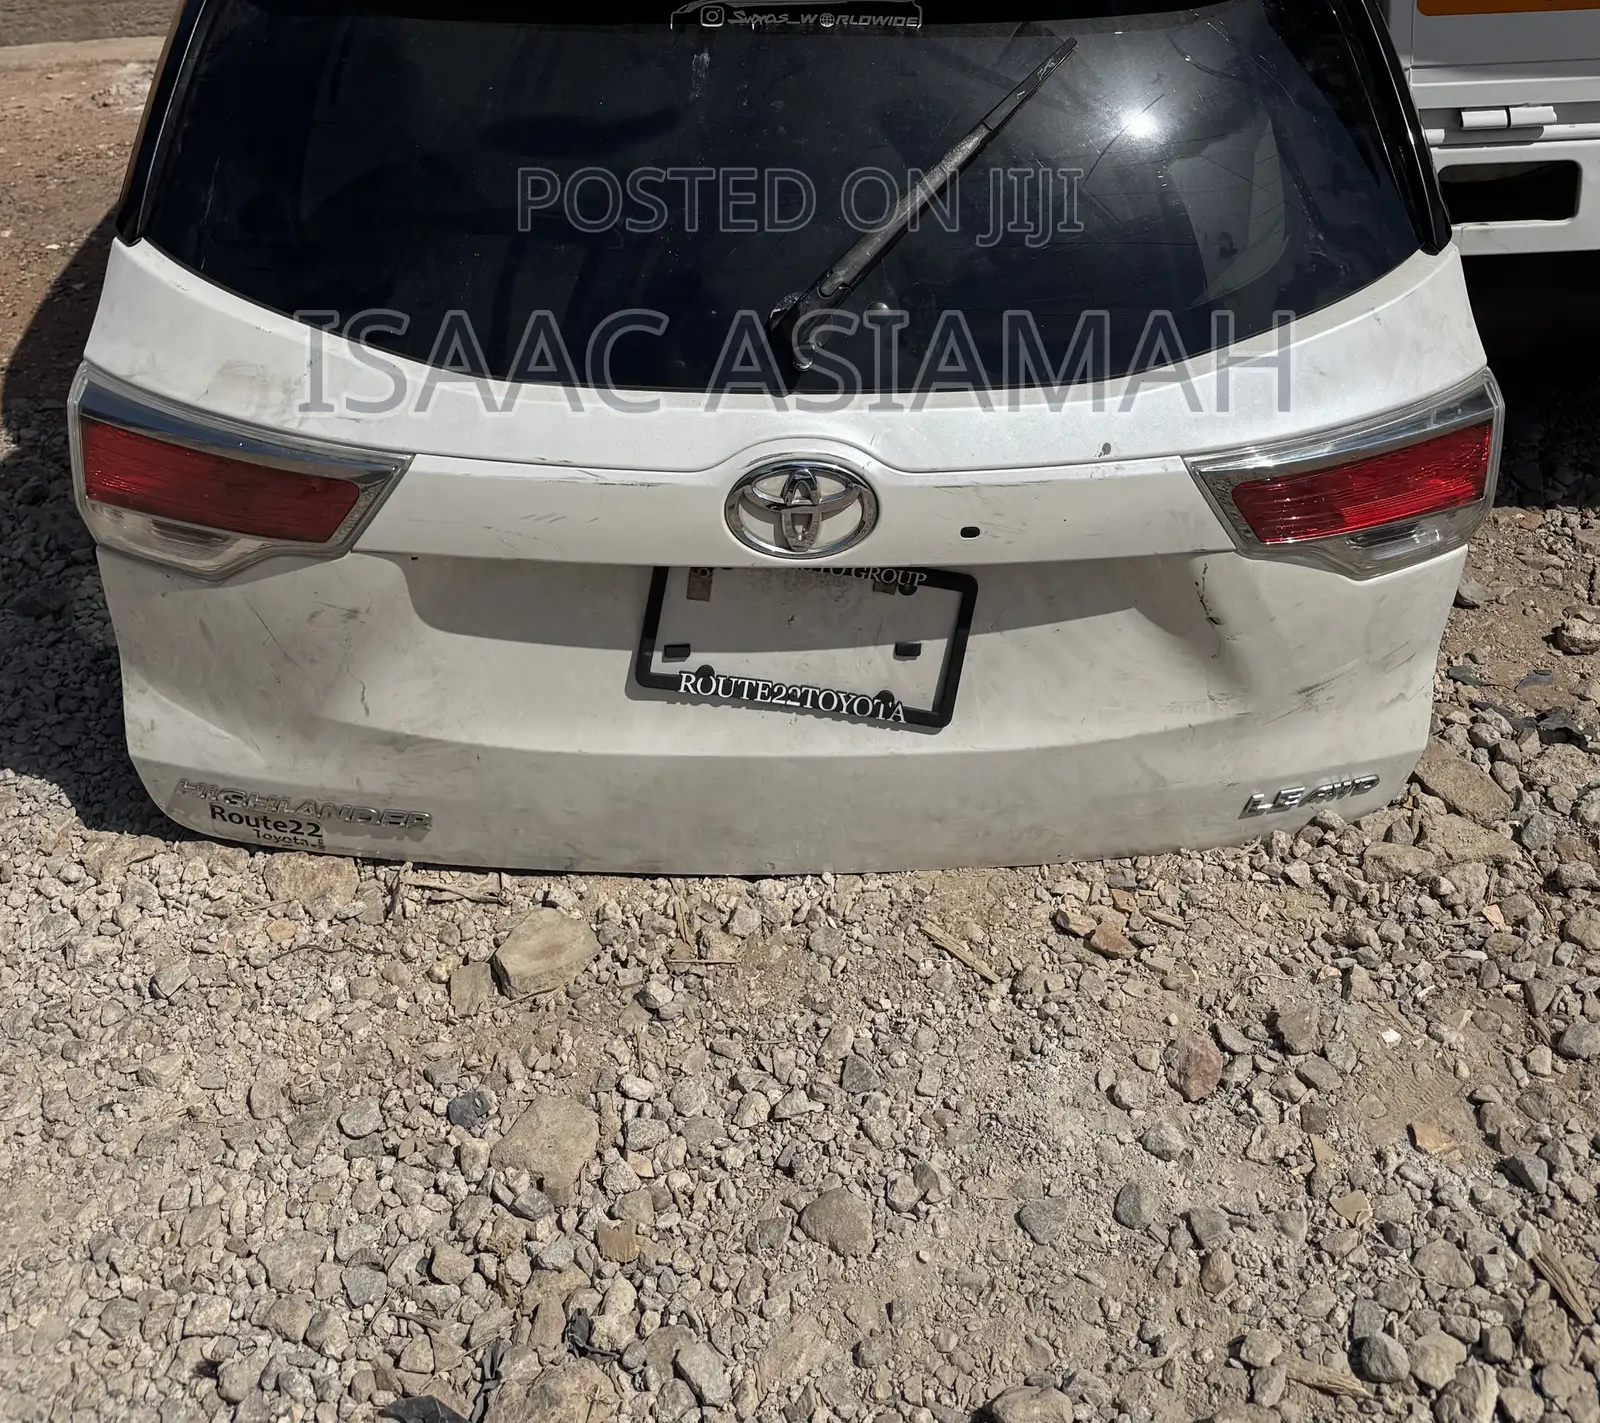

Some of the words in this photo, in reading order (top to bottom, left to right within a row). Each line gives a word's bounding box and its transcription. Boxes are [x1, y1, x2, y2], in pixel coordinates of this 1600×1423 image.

[851, 566, 927, 588] GROUP
[678, 672, 907, 723] ROUTE22TOYOTA
[174, 779, 433, 830] HIGHLANDER
[1238, 786, 1305, 820] LE
[209, 804, 323, 838] Route22
[252, 828, 309, 848] Toyota
